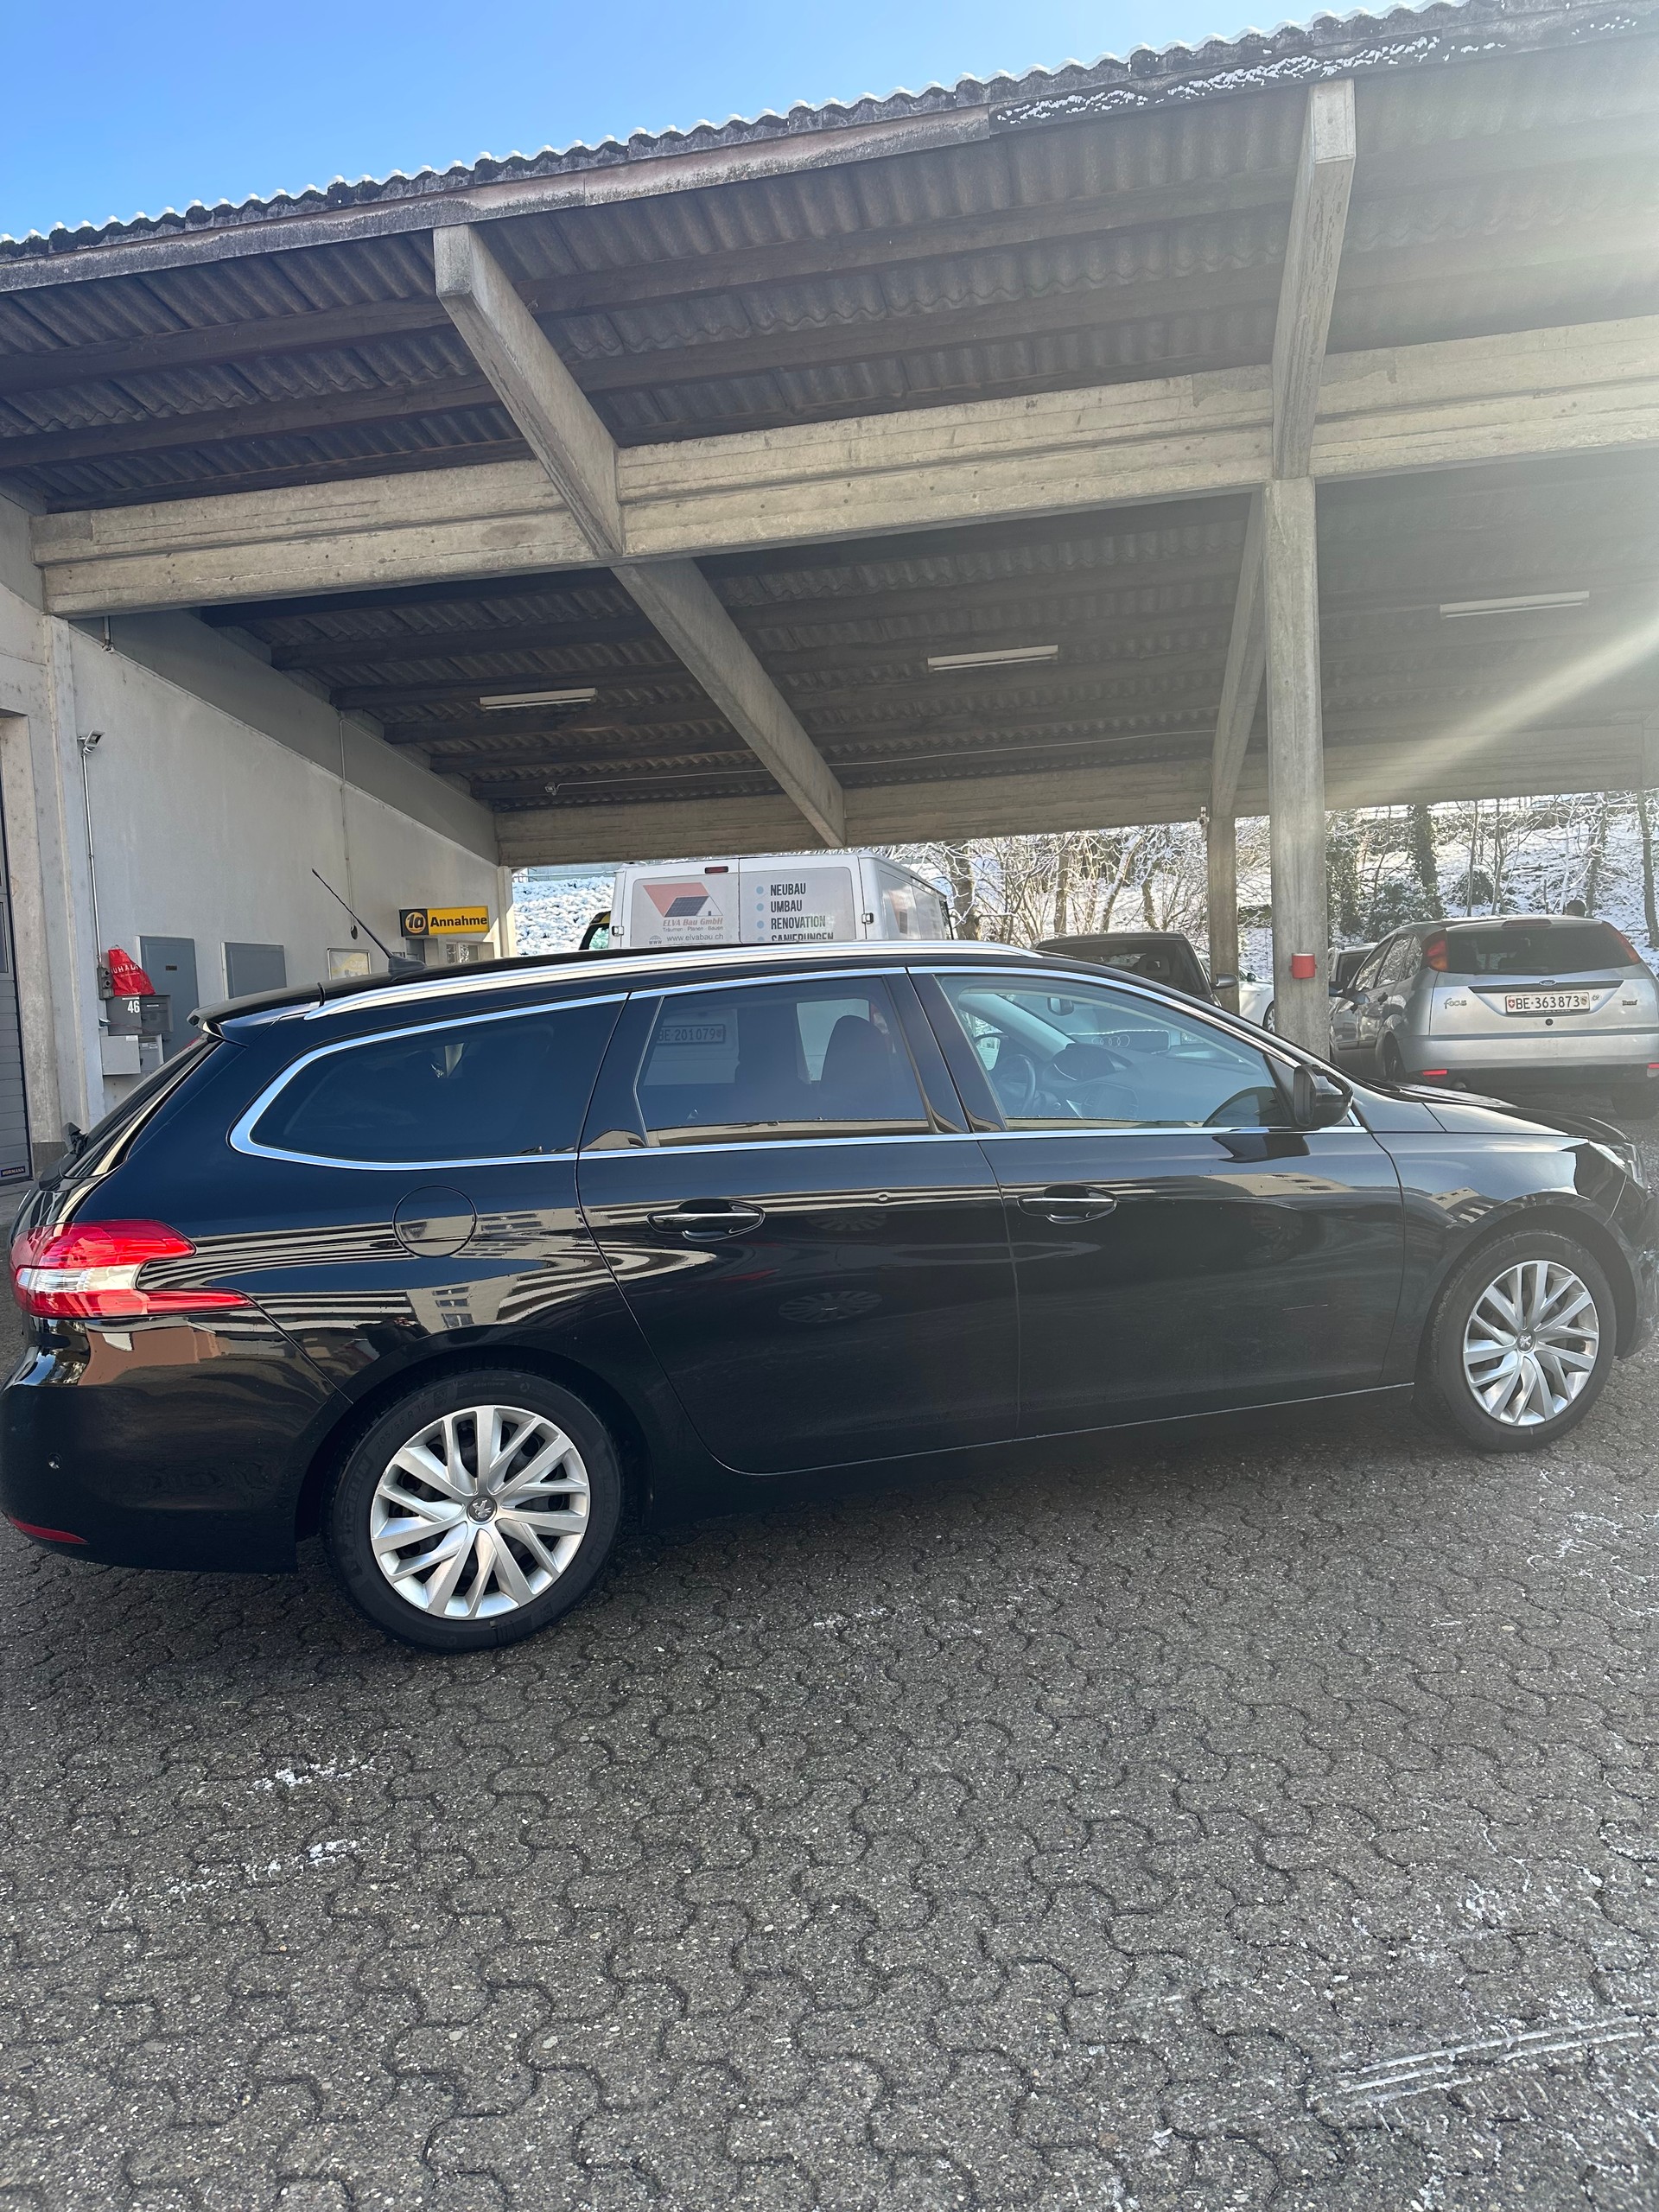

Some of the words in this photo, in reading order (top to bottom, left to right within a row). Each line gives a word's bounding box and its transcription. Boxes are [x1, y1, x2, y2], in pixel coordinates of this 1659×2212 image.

[770, 882, 806, 896] NEUBAU
[770, 899, 803, 912] UMBAU
[430, 915, 487, 927] Annahme
[700, 917, 723, 925] GmbH
[771, 915, 826, 930] RENOVATION
[666, 933, 724, 942] www.elvabau.ch
[127, 1000, 140, 1014] 46
